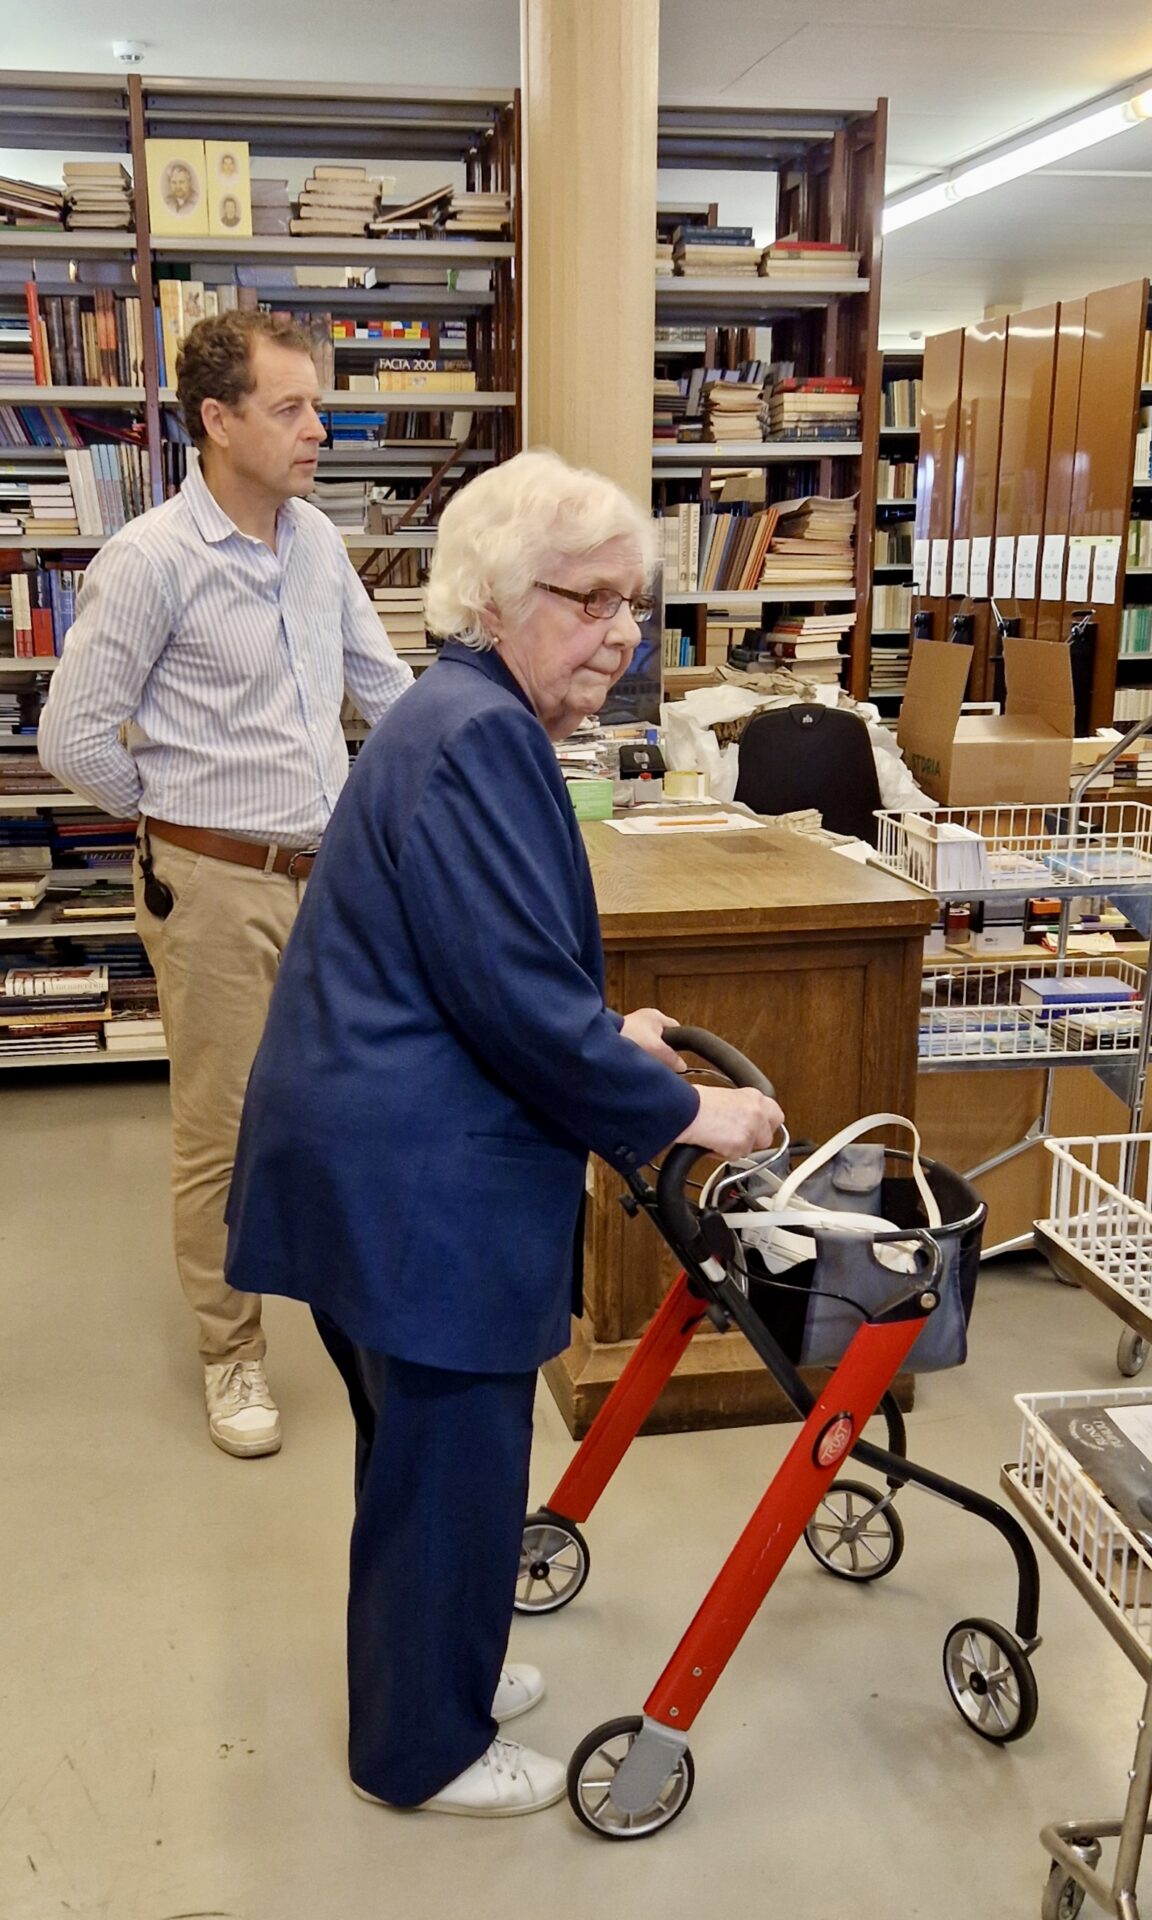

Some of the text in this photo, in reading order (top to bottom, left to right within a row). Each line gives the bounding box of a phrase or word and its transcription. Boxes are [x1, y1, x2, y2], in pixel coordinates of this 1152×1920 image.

[379, 358, 410, 370] FACTA
[413, 359, 437, 371] 2001
[820, 1421, 848, 1460] TRUST
